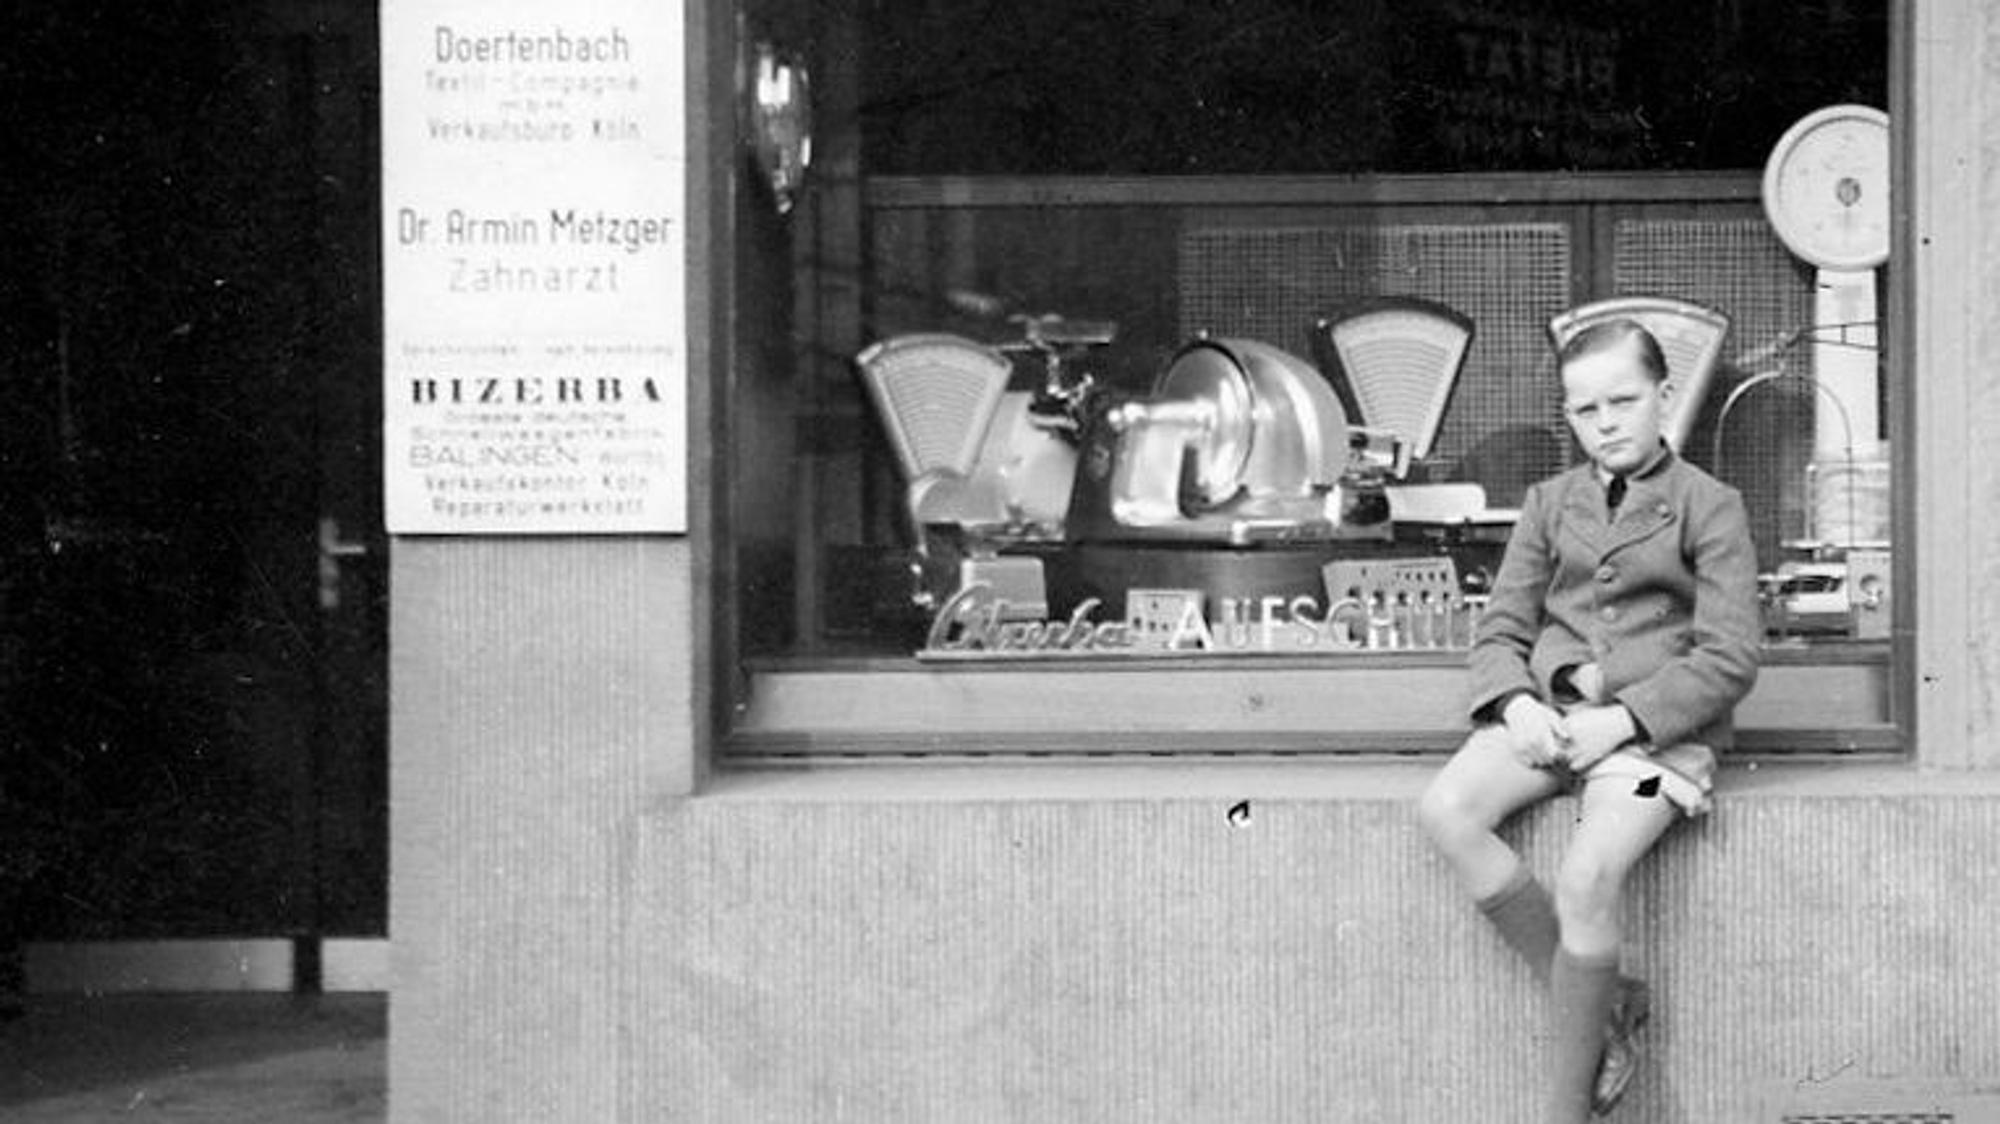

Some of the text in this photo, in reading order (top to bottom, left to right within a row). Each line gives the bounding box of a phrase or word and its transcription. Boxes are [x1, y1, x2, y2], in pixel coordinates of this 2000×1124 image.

[436, 26, 629, 63] Doertenbach
[446, 208, 538, 244] Armin
[551, 208, 673, 254] Metzger
[449, 257, 619, 293] Zahnarzt
[411, 378, 664, 403] BIZERBA
[410, 445, 579, 469] BALINGEN
